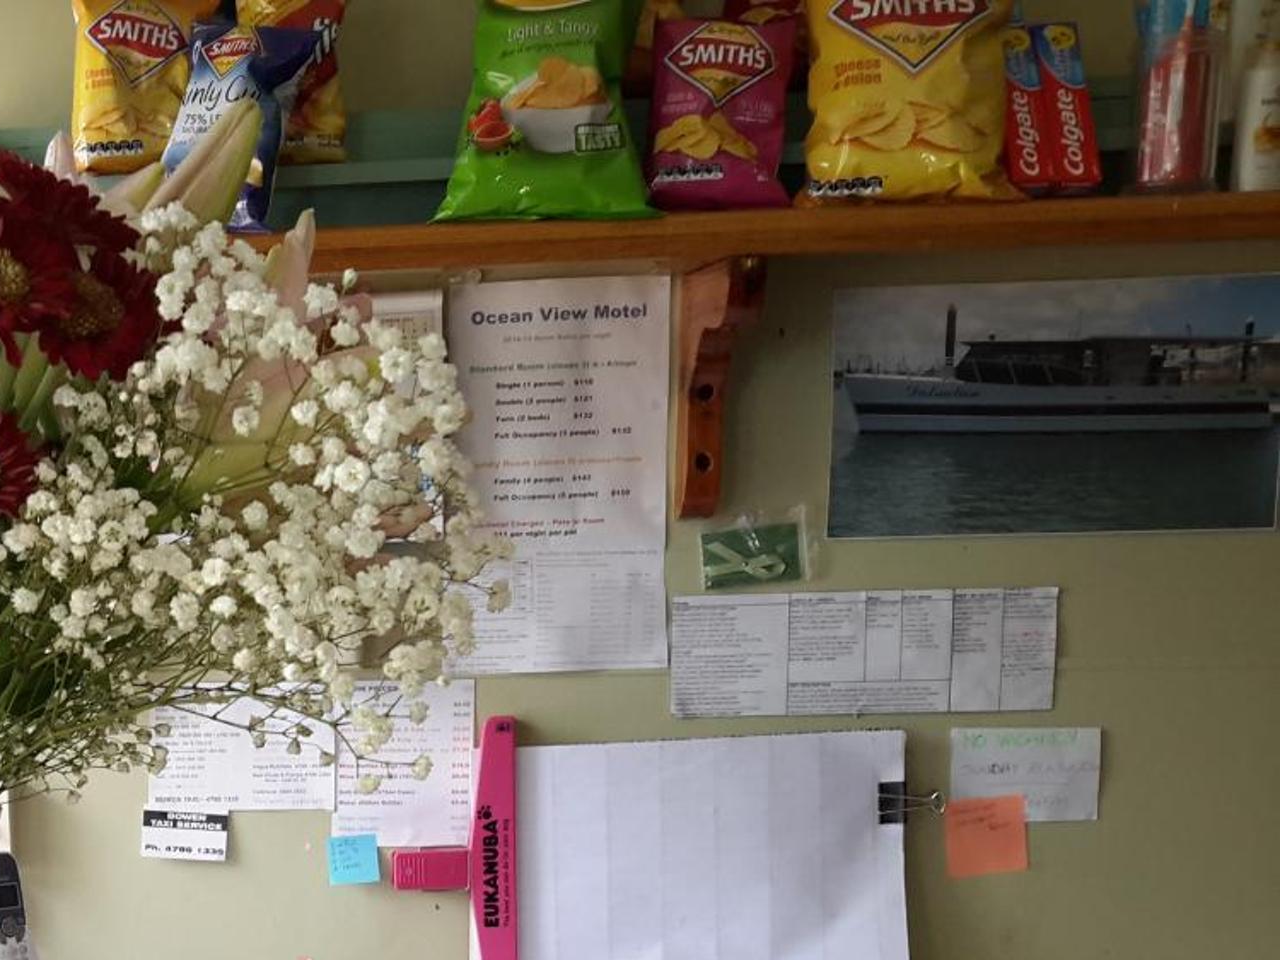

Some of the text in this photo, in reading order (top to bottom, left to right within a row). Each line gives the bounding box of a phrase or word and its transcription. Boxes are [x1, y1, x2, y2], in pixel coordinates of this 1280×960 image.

[507, 18, 600, 42] Light & Tangy
[184, 113, 208, 126] 75%
[578, 133, 621, 150] TASTY
[1018, 91, 1041, 176] Colgate
[1063, 88, 1085, 177] Colgate
[471, 303, 648, 325] Ocean View Motel
[150, 819, 223, 830] TAXI SERVICE
[167, 813, 207, 821] BOWEN
[481, 819, 500, 929] EUKANUBA
